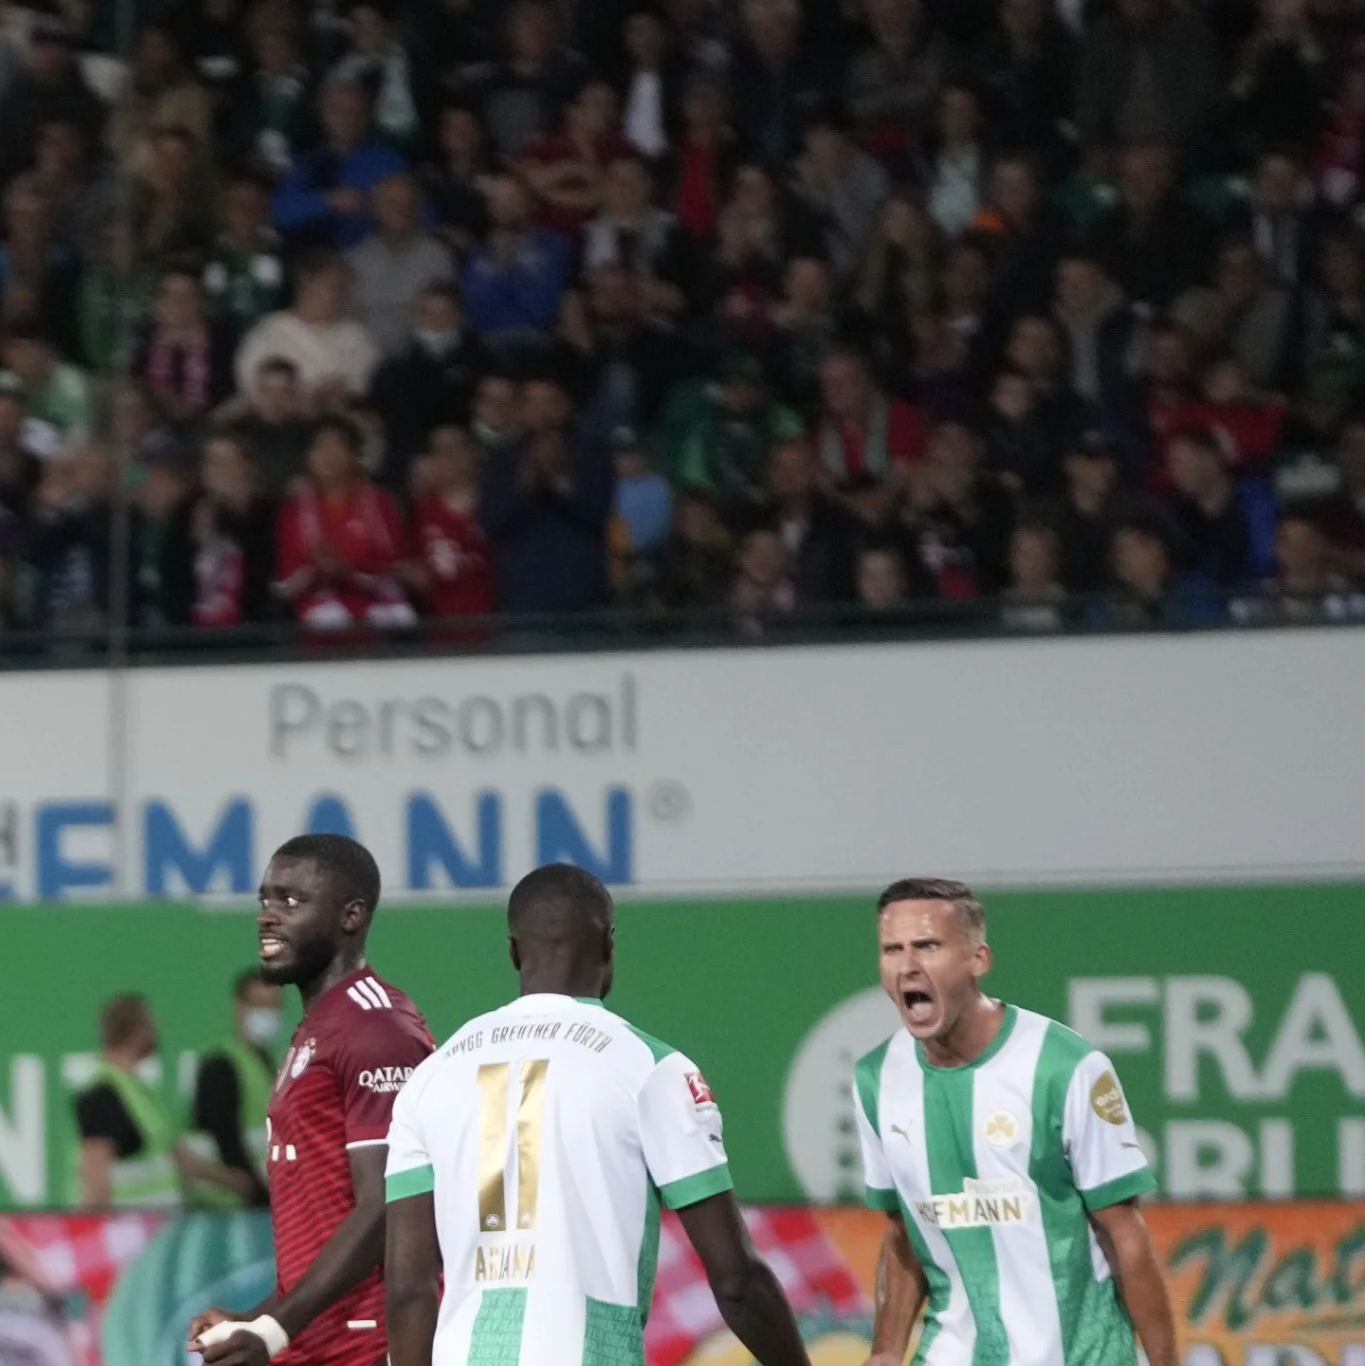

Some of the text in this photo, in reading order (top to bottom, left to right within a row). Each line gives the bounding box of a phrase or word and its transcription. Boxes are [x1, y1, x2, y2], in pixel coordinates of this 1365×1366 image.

[270, 671, 638, 762] Personal
[491, 1021, 562, 1044] GREUTHER
[564, 1020, 614, 1054] FÜRTH
[476, 1058, 550, 1233] 11
